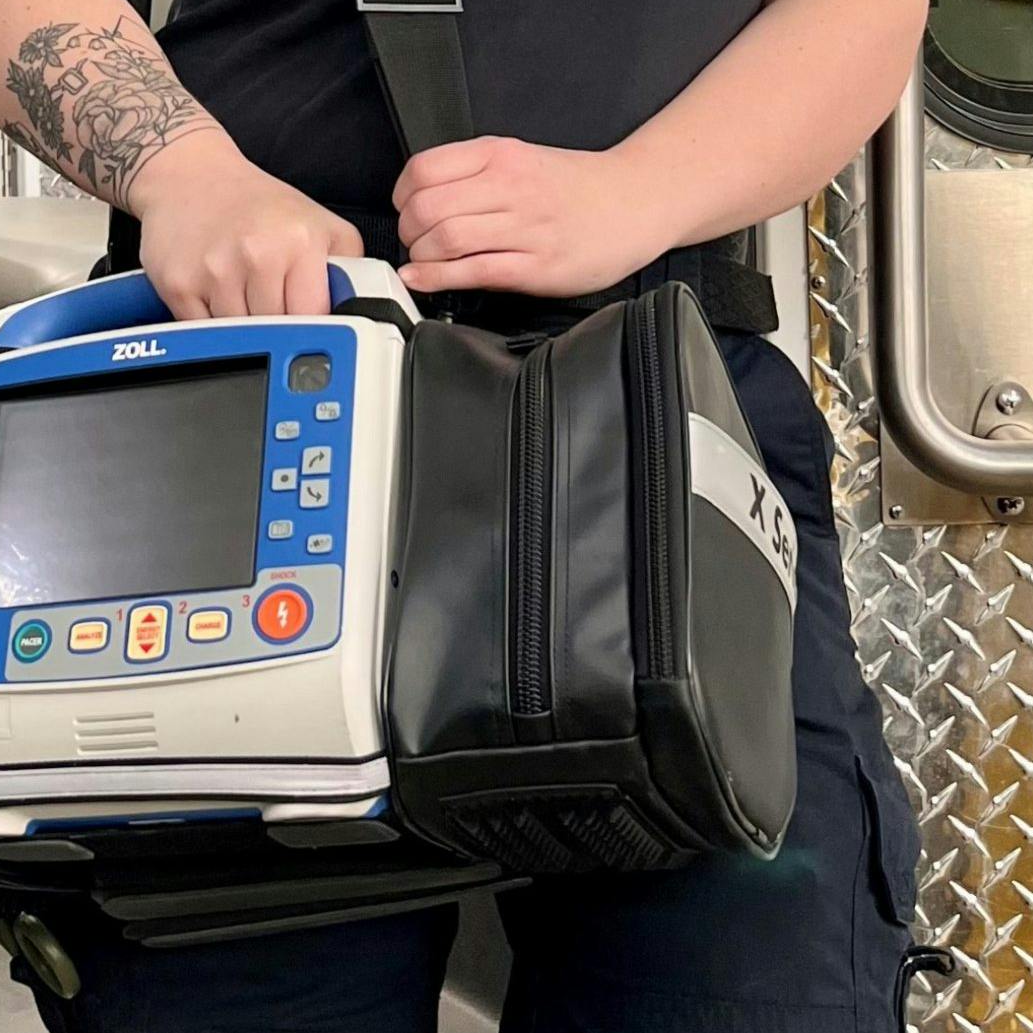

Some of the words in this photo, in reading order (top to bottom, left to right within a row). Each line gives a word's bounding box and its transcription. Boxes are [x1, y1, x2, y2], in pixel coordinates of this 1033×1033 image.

[749, 472, 766, 533] X
[270, 569, 297, 580] SHOCK
[178, 601, 188, 614] 2
[242, 595, 251, 608] 3
[116, 609, 124, 621] 1
[19, 635, 43, 647] PACER
